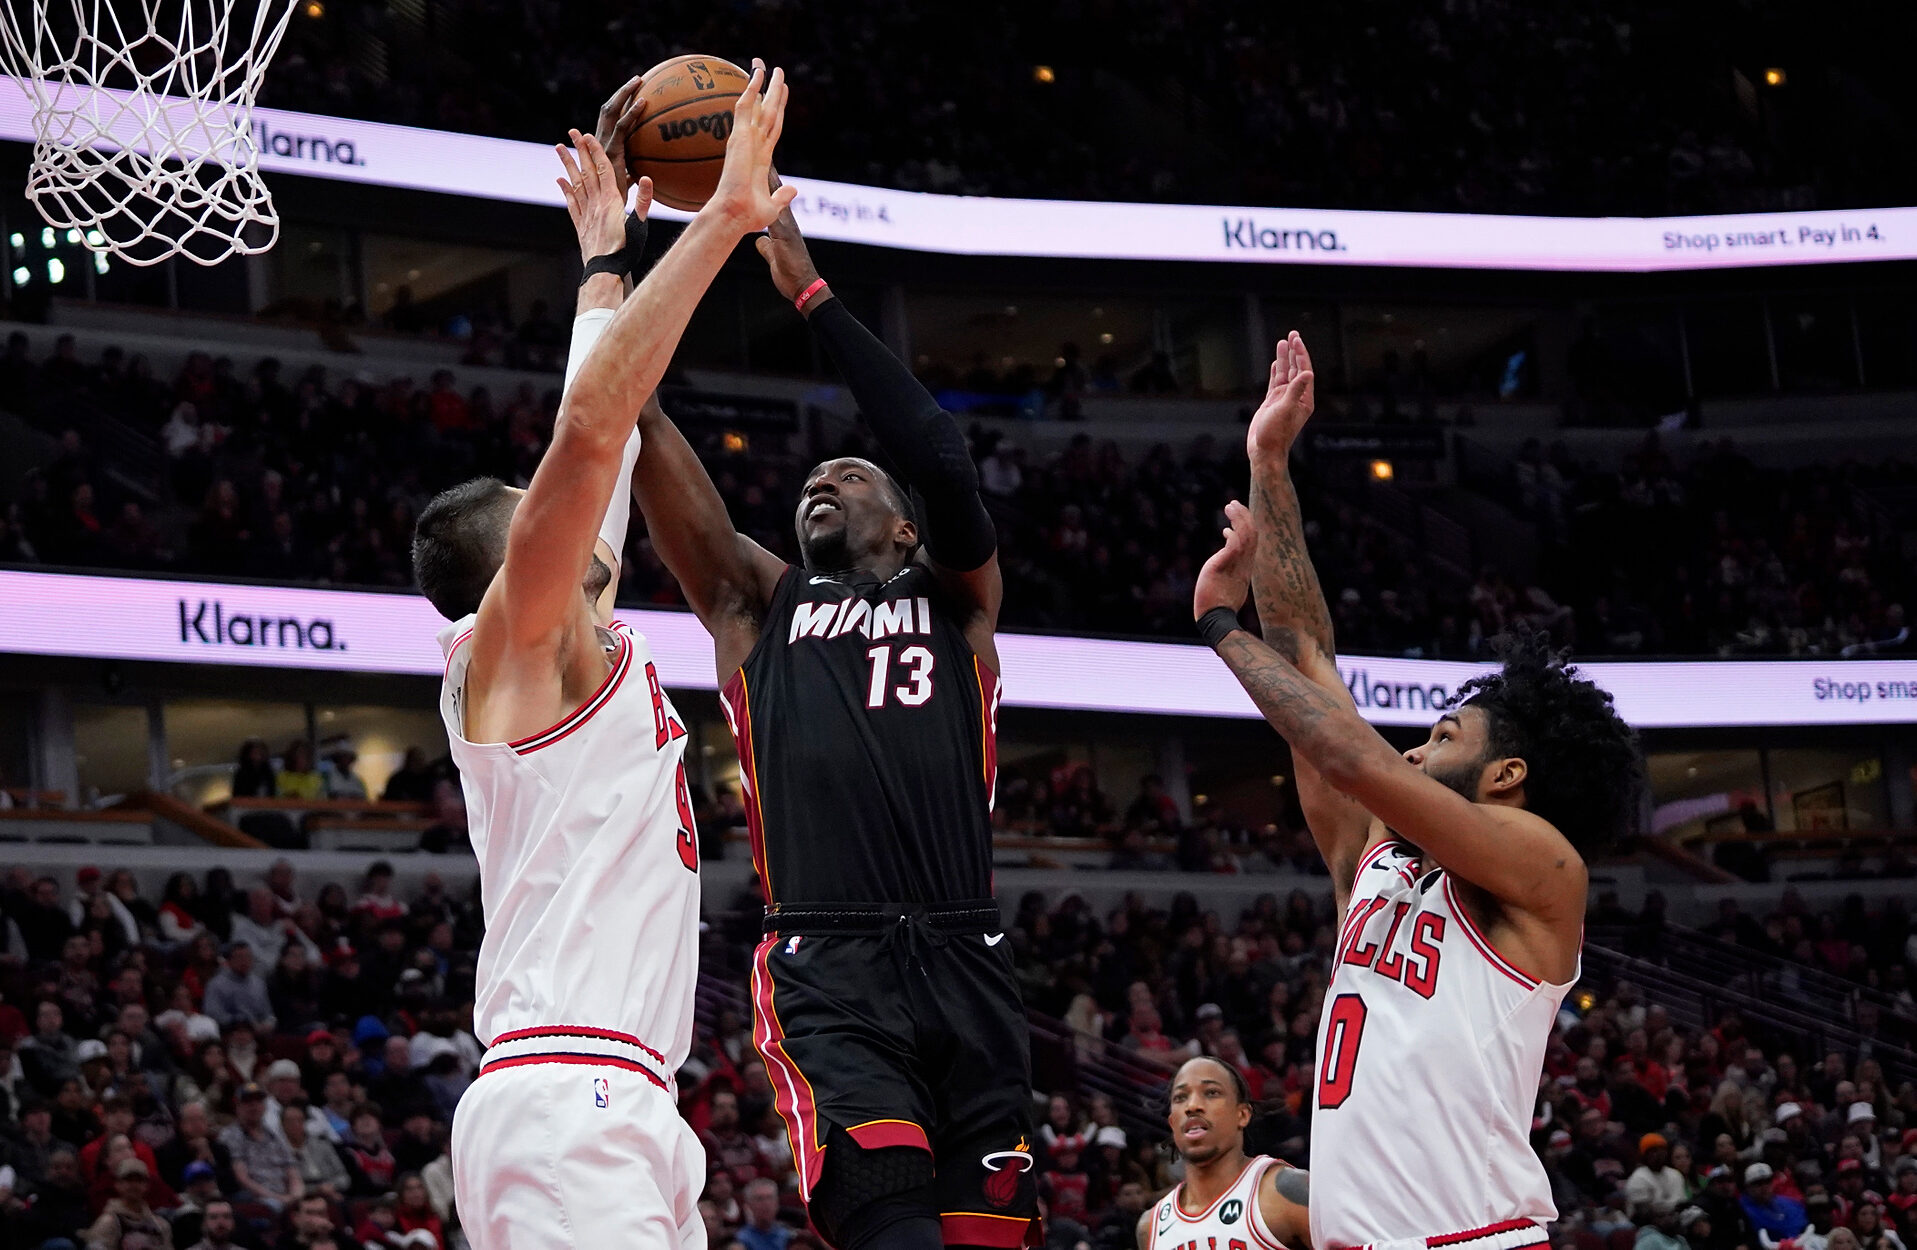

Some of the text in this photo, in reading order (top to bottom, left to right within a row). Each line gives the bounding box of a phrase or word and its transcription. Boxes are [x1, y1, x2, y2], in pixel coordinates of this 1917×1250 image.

[1223, 217, 1347, 251] Klarna.
[1663, 231, 1720, 251] Shop
[1798, 226, 1836, 247] Pay
[1840, 222, 1861, 241] in
[179, 599, 347, 651] Klarna.
[787, 597, 932, 646] MIAMI
[865, 643, 936, 709] 13
[1813, 677, 1871, 703] Shop
[1318, 993, 1368, 1111] 0
